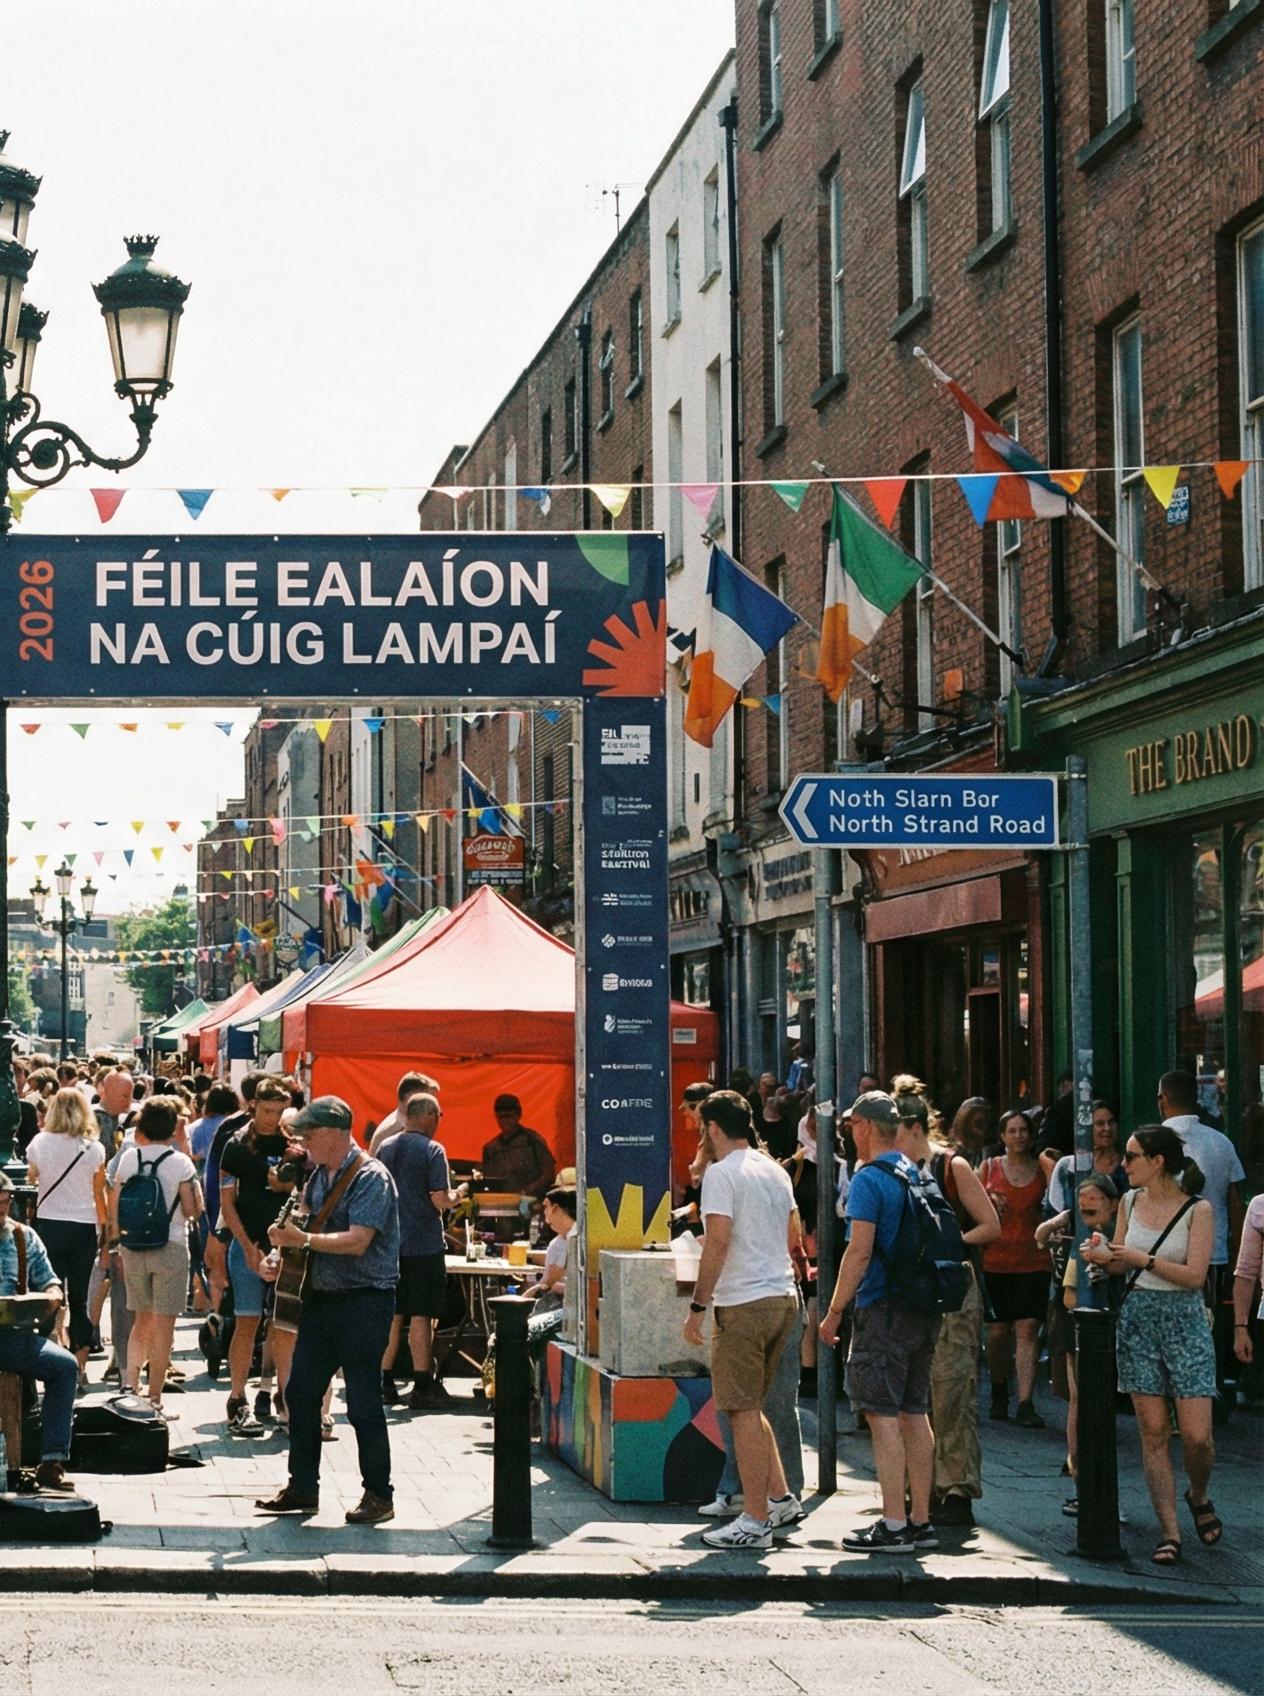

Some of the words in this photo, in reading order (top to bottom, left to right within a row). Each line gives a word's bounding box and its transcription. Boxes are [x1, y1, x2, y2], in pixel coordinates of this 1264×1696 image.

[96, 548, 258, 607] FÉILE
[277, 548, 550, 607] EALAÍON
[19, 560, 54, 662] 2026
[90, 622, 170, 664] NA
[186, 610, 324, 665] CÚIG
[343, 610, 562, 664] LAMPAÍ
[1125, 739, 1167, 794] THE
[1174, 714, 1251, 784] BRAND
[829, 789, 885, 808] Noth
[895, 789, 952, 808] Slarn
[962, 790, 1000, 808] Bor
[829, 814, 893, 833] North
[903, 814, 978, 833] Strand
[989, 815, 1045, 834] Road
